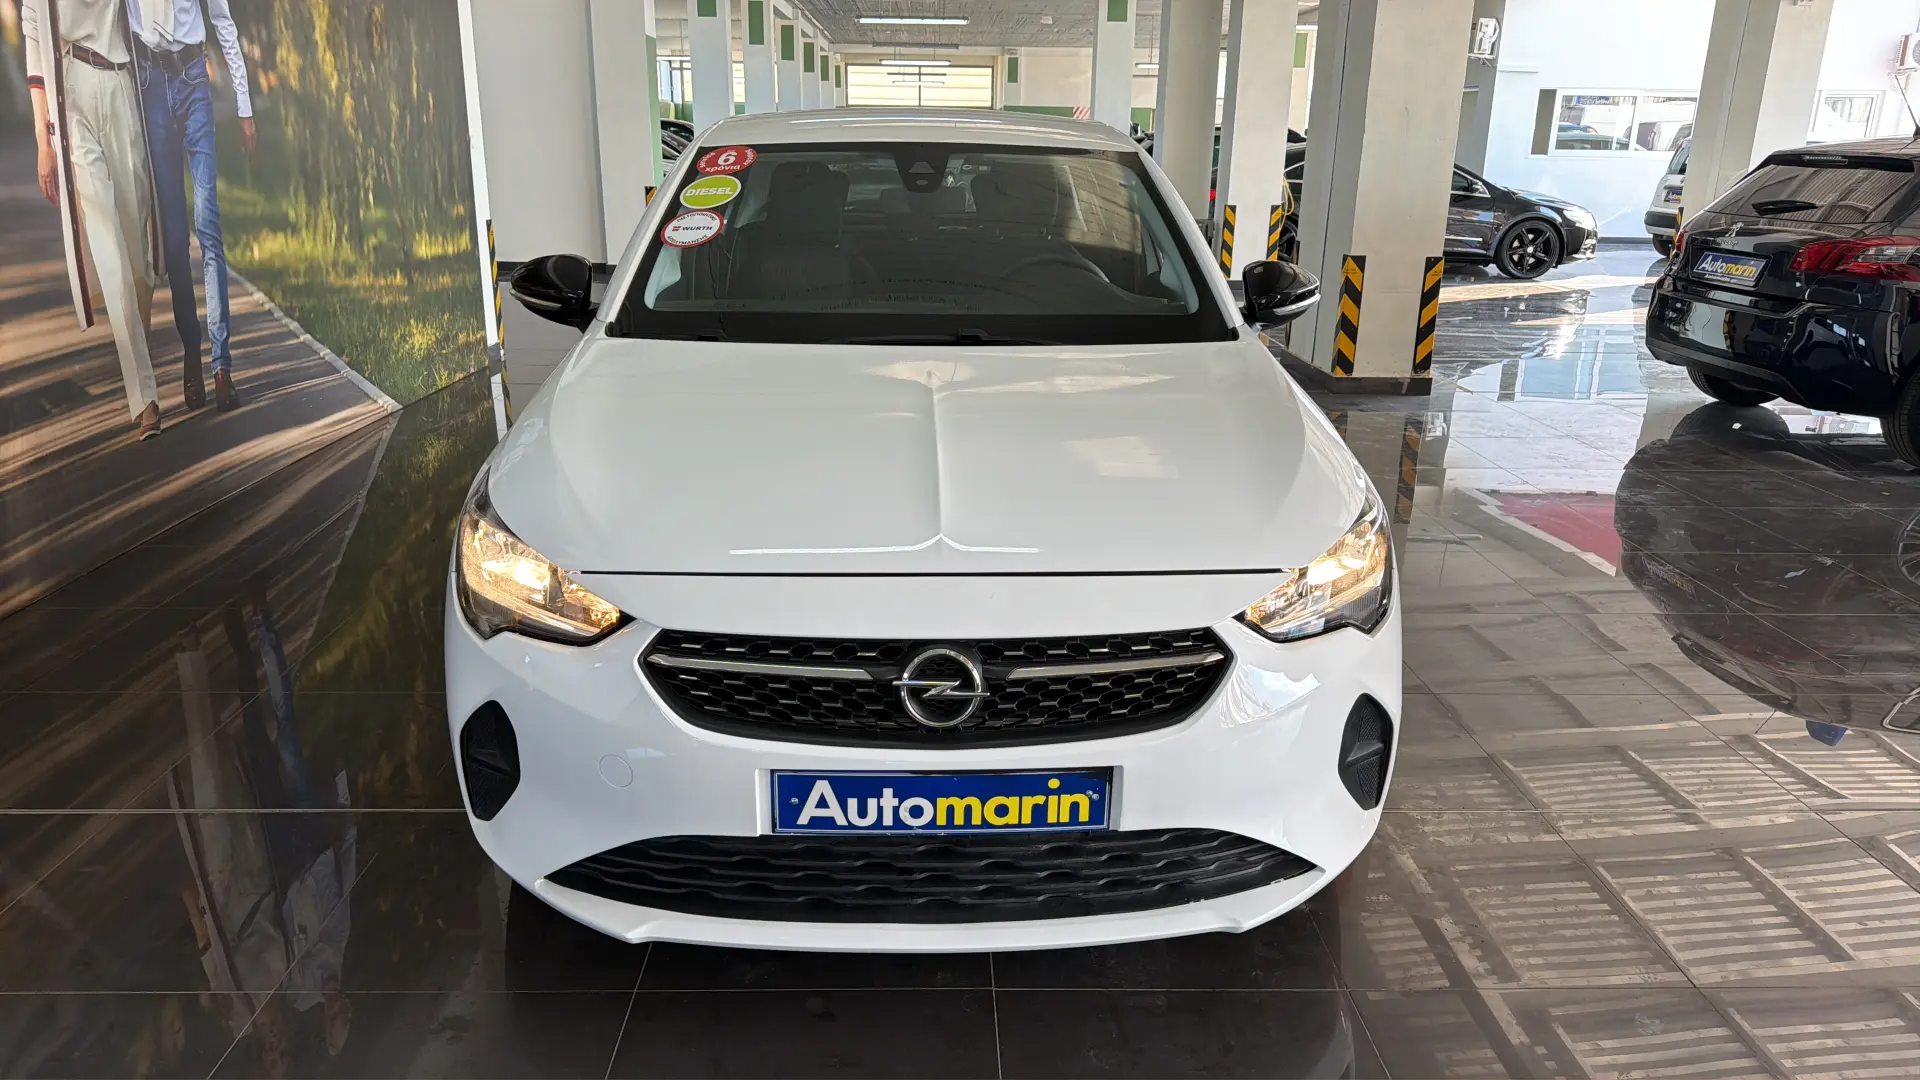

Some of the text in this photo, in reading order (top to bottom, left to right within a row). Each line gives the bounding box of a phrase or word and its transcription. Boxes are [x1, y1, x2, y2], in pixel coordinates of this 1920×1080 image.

[718, 151, 737, 165] 6
[705, 164, 740, 172] χρόνια
[685, 187, 733, 196] DIESEL
[1698, 255, 1756, 277] Automarin
[796, 778, 1090, 827] Automarin
